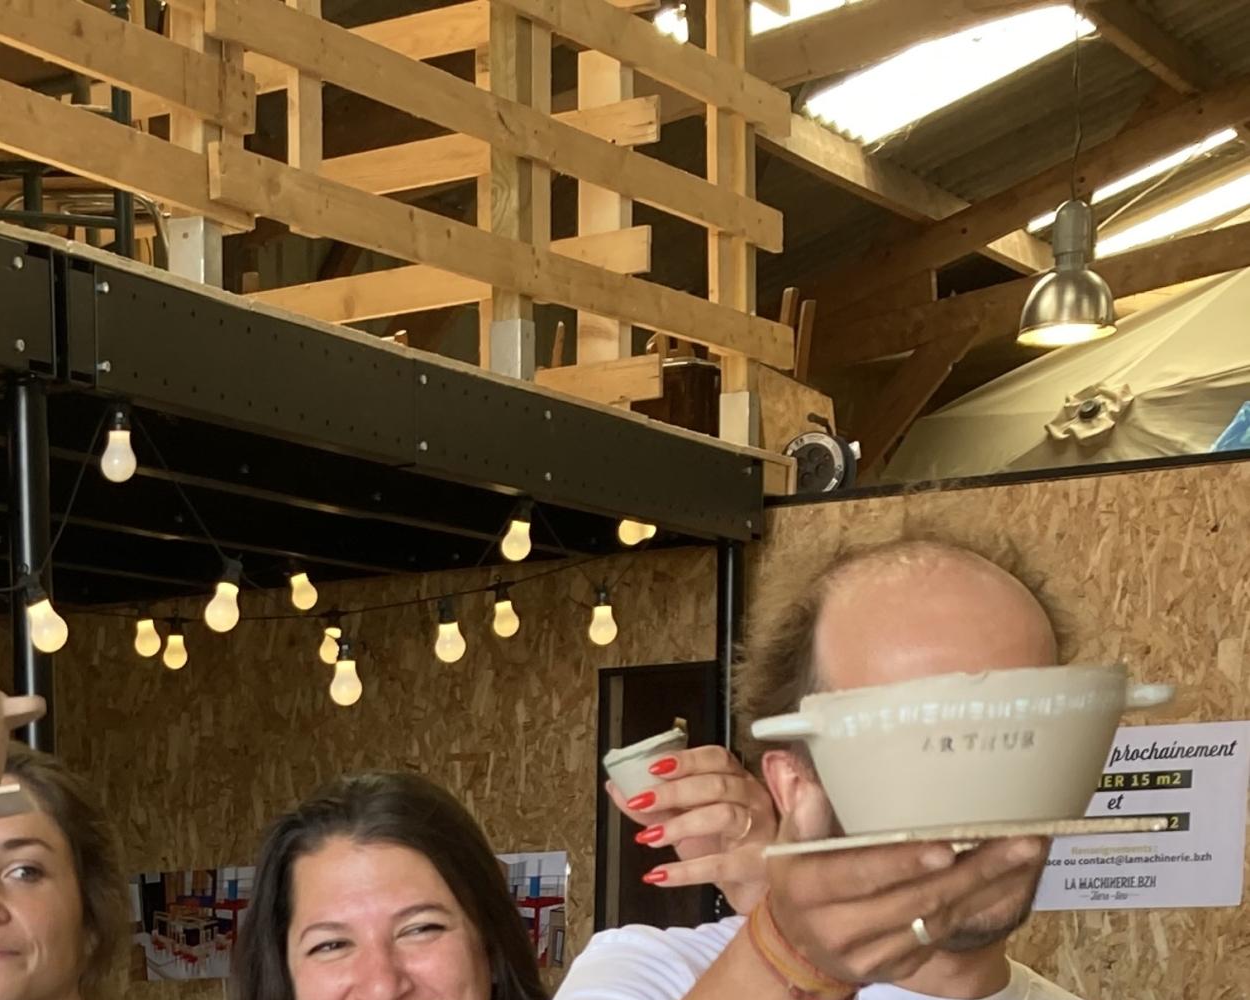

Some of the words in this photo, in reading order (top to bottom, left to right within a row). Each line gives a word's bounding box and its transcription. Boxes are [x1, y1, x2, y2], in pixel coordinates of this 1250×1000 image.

[1109, 740, 1238, 767] prochainement
[1131, 773, 1150, 787] 15
[1156, 772, 1181, 786] m2
[1107, 793, 1125, 810] et
[1064, 858, 1076, 867] ou
[1078, 852, 1212, 867] contact@lamachinerie.bzh
[1064, 877, 1077, 890] LA
